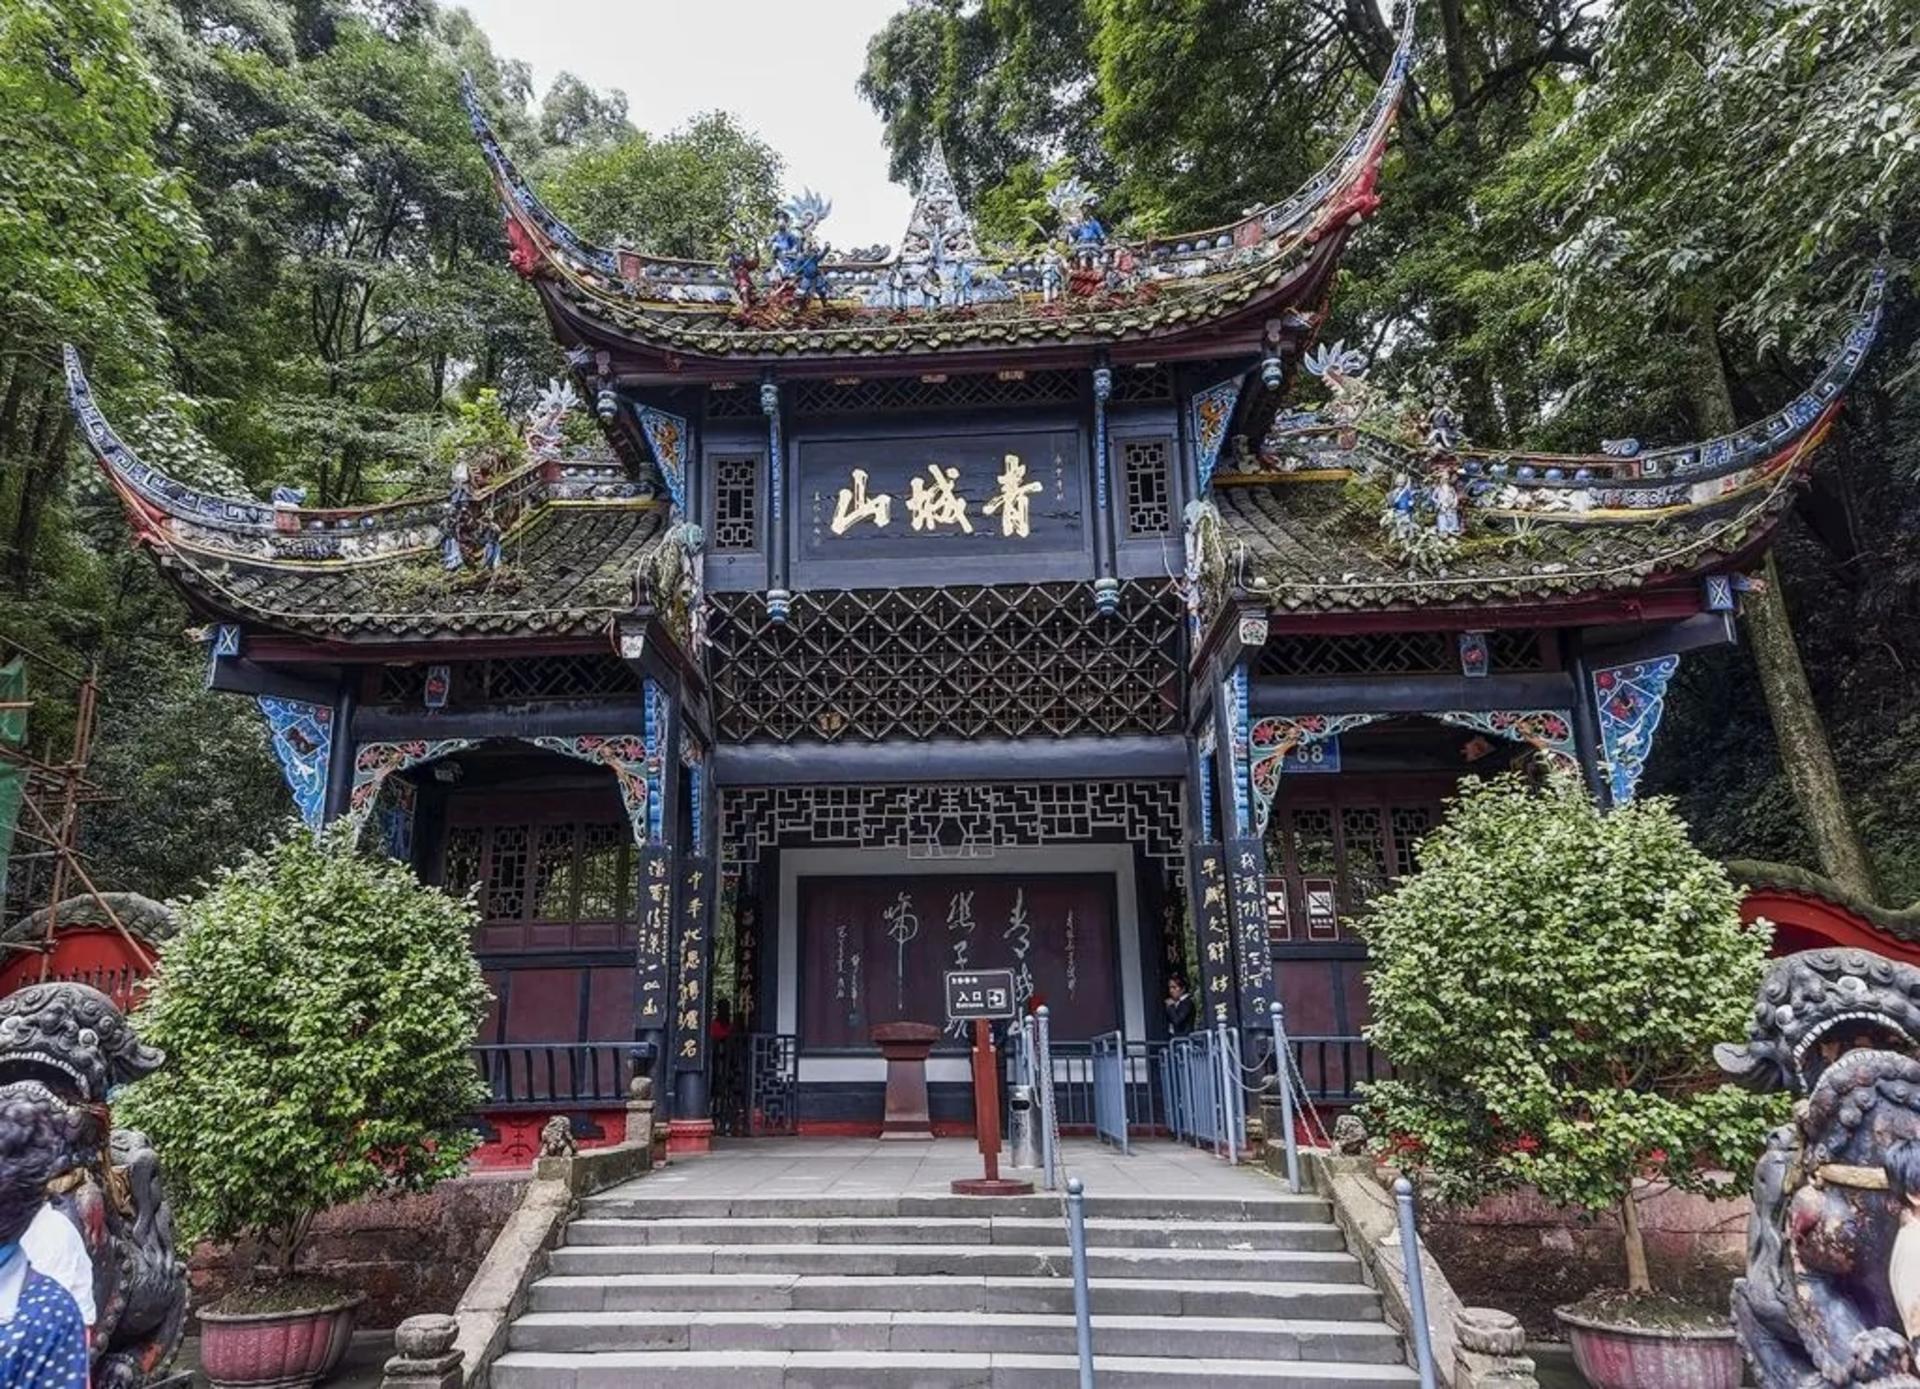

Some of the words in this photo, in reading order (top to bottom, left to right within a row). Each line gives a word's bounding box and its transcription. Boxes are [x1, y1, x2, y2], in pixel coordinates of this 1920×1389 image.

[831, 454, 1043, 538] 青城山
[957, 991, 982, 1002] 入口
